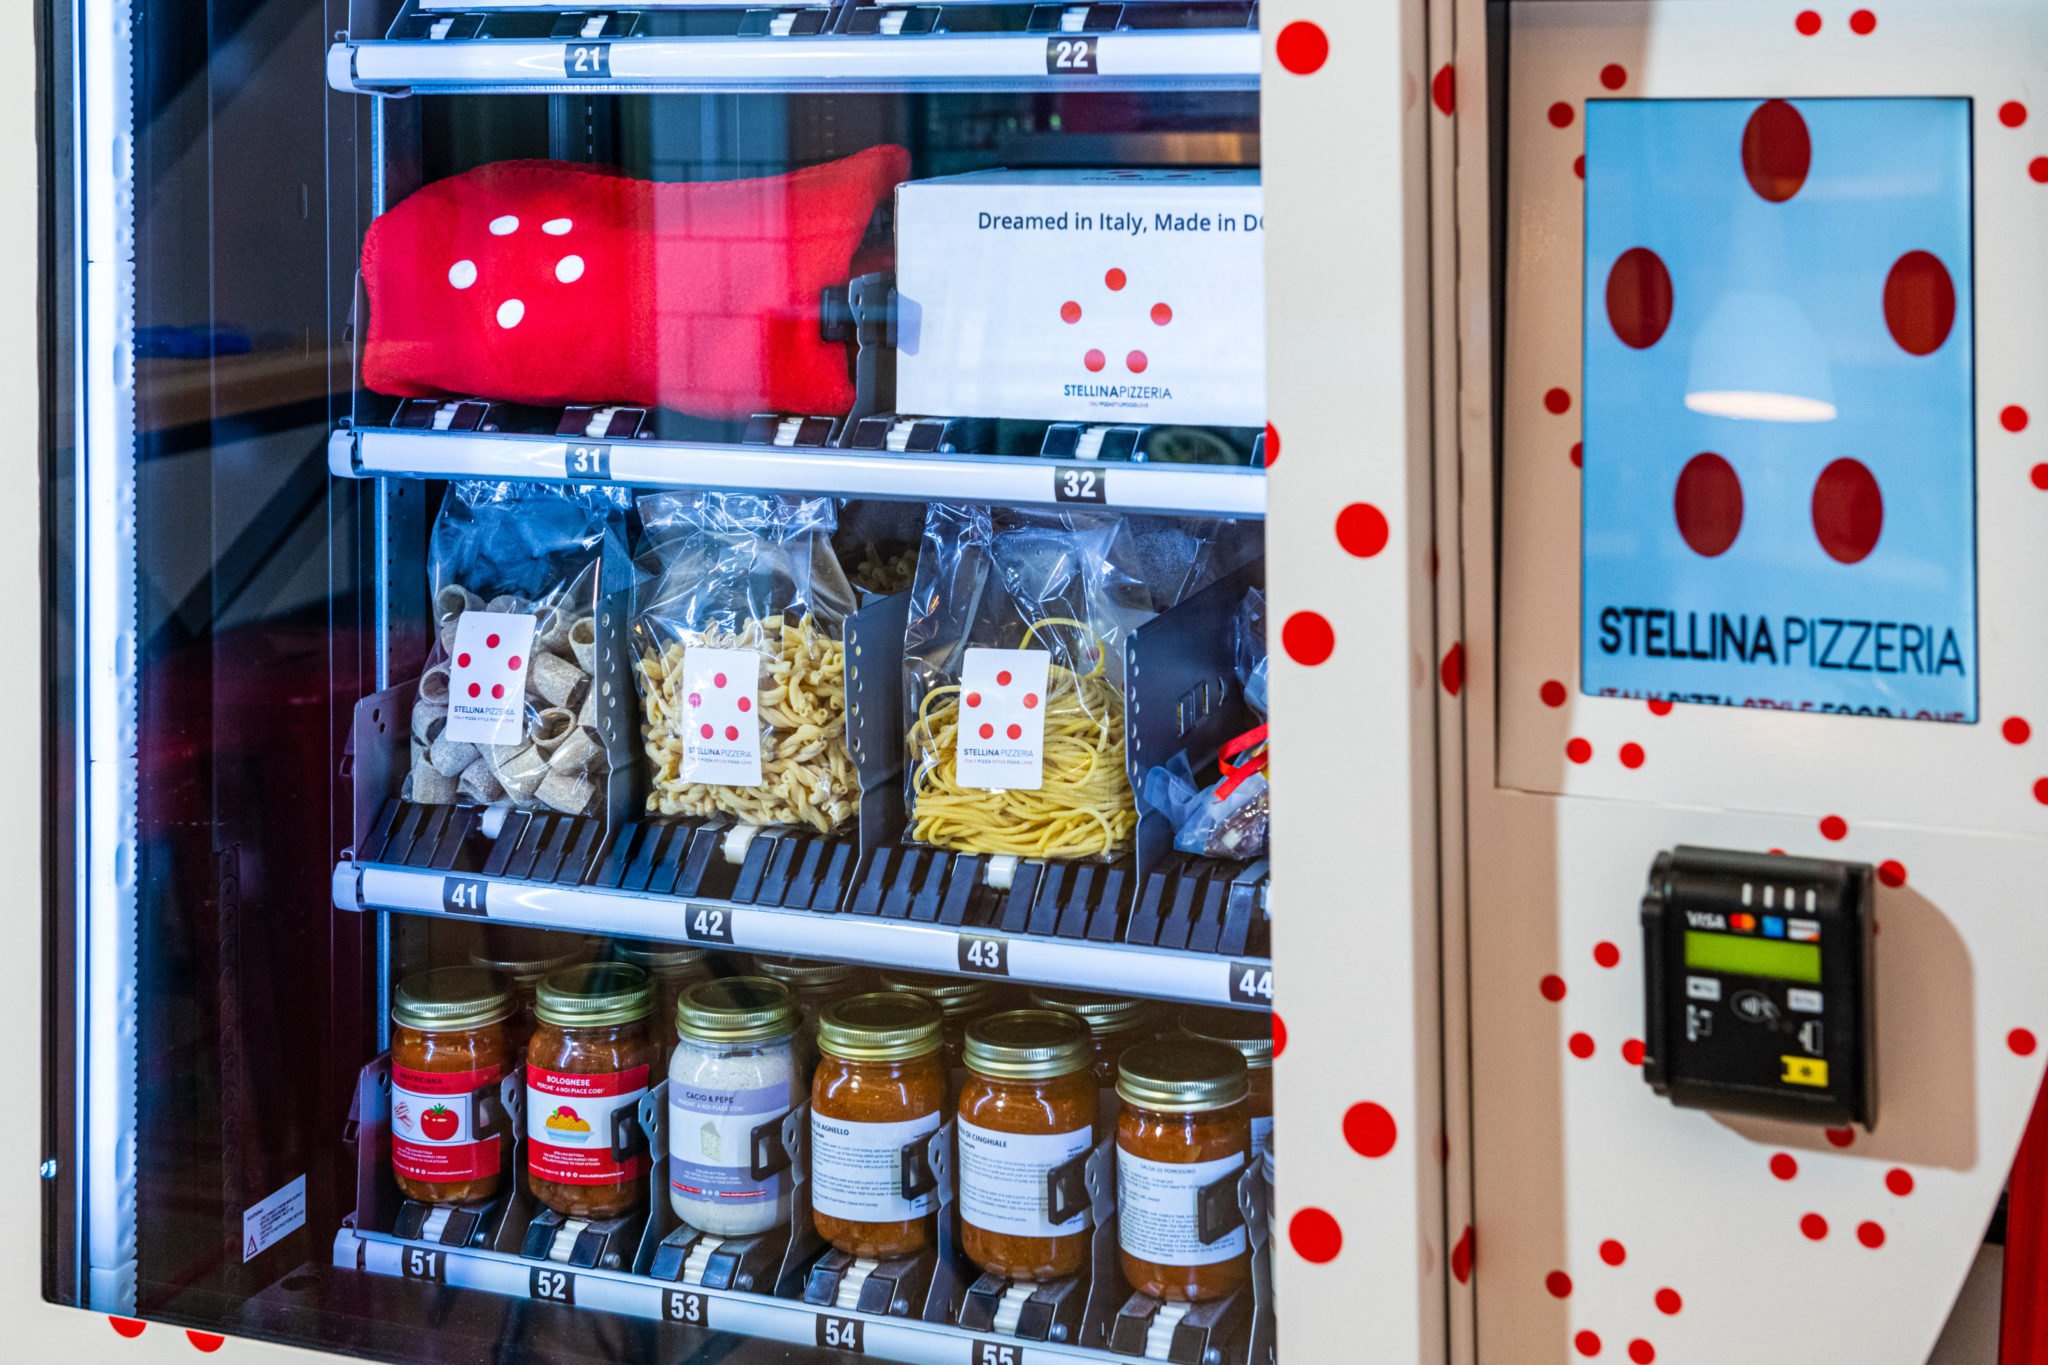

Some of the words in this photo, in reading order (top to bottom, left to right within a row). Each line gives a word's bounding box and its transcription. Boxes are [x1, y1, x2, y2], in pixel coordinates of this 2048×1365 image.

[573, 47, 600, 71] 21
[1056, 41, 1088, 67] 22
[979, 212, 1068, 230] Dreamed
[1075, 212, 1092, 230] in
[1099, 213, 1147, 236] Italy,
[1154, 213, 1211, 231] Made
[1218, 214, 1236, 232] in
[573, 450, 599, 472] 31
[1064, 471, 1095, 496] 32
[454, 705, 485, 714] STELLINA
[963, 748, 1000, 757] STELLINA
[1000, 749, 1034, 758] PIZZERIA
[452, 883, 477, 909] 41
[694, 910, 723, 939] 42
[1685, 910, 1727, 931] VISA
[968, 938, 1000, 968] 43
[1239, 968, 1273, 1000] 44
[546, 1074, 591, 1087] BOLOGNESE
[686, 1091, 707, 1102] CACIO
[708, 1095, 714, 1103] &
[821, 1123, 850, 1136] AGNELLO
[971, 1133, 1007, 1148] CINGHIALE
[411, 1250, 436, 1277] 51
[539, 1272, 565, 1299] 52
[672, 1293, 699, 1321] 53
[826, 1319, 856, 1348] 54
[983, 1343, 1014, 1365] 55
